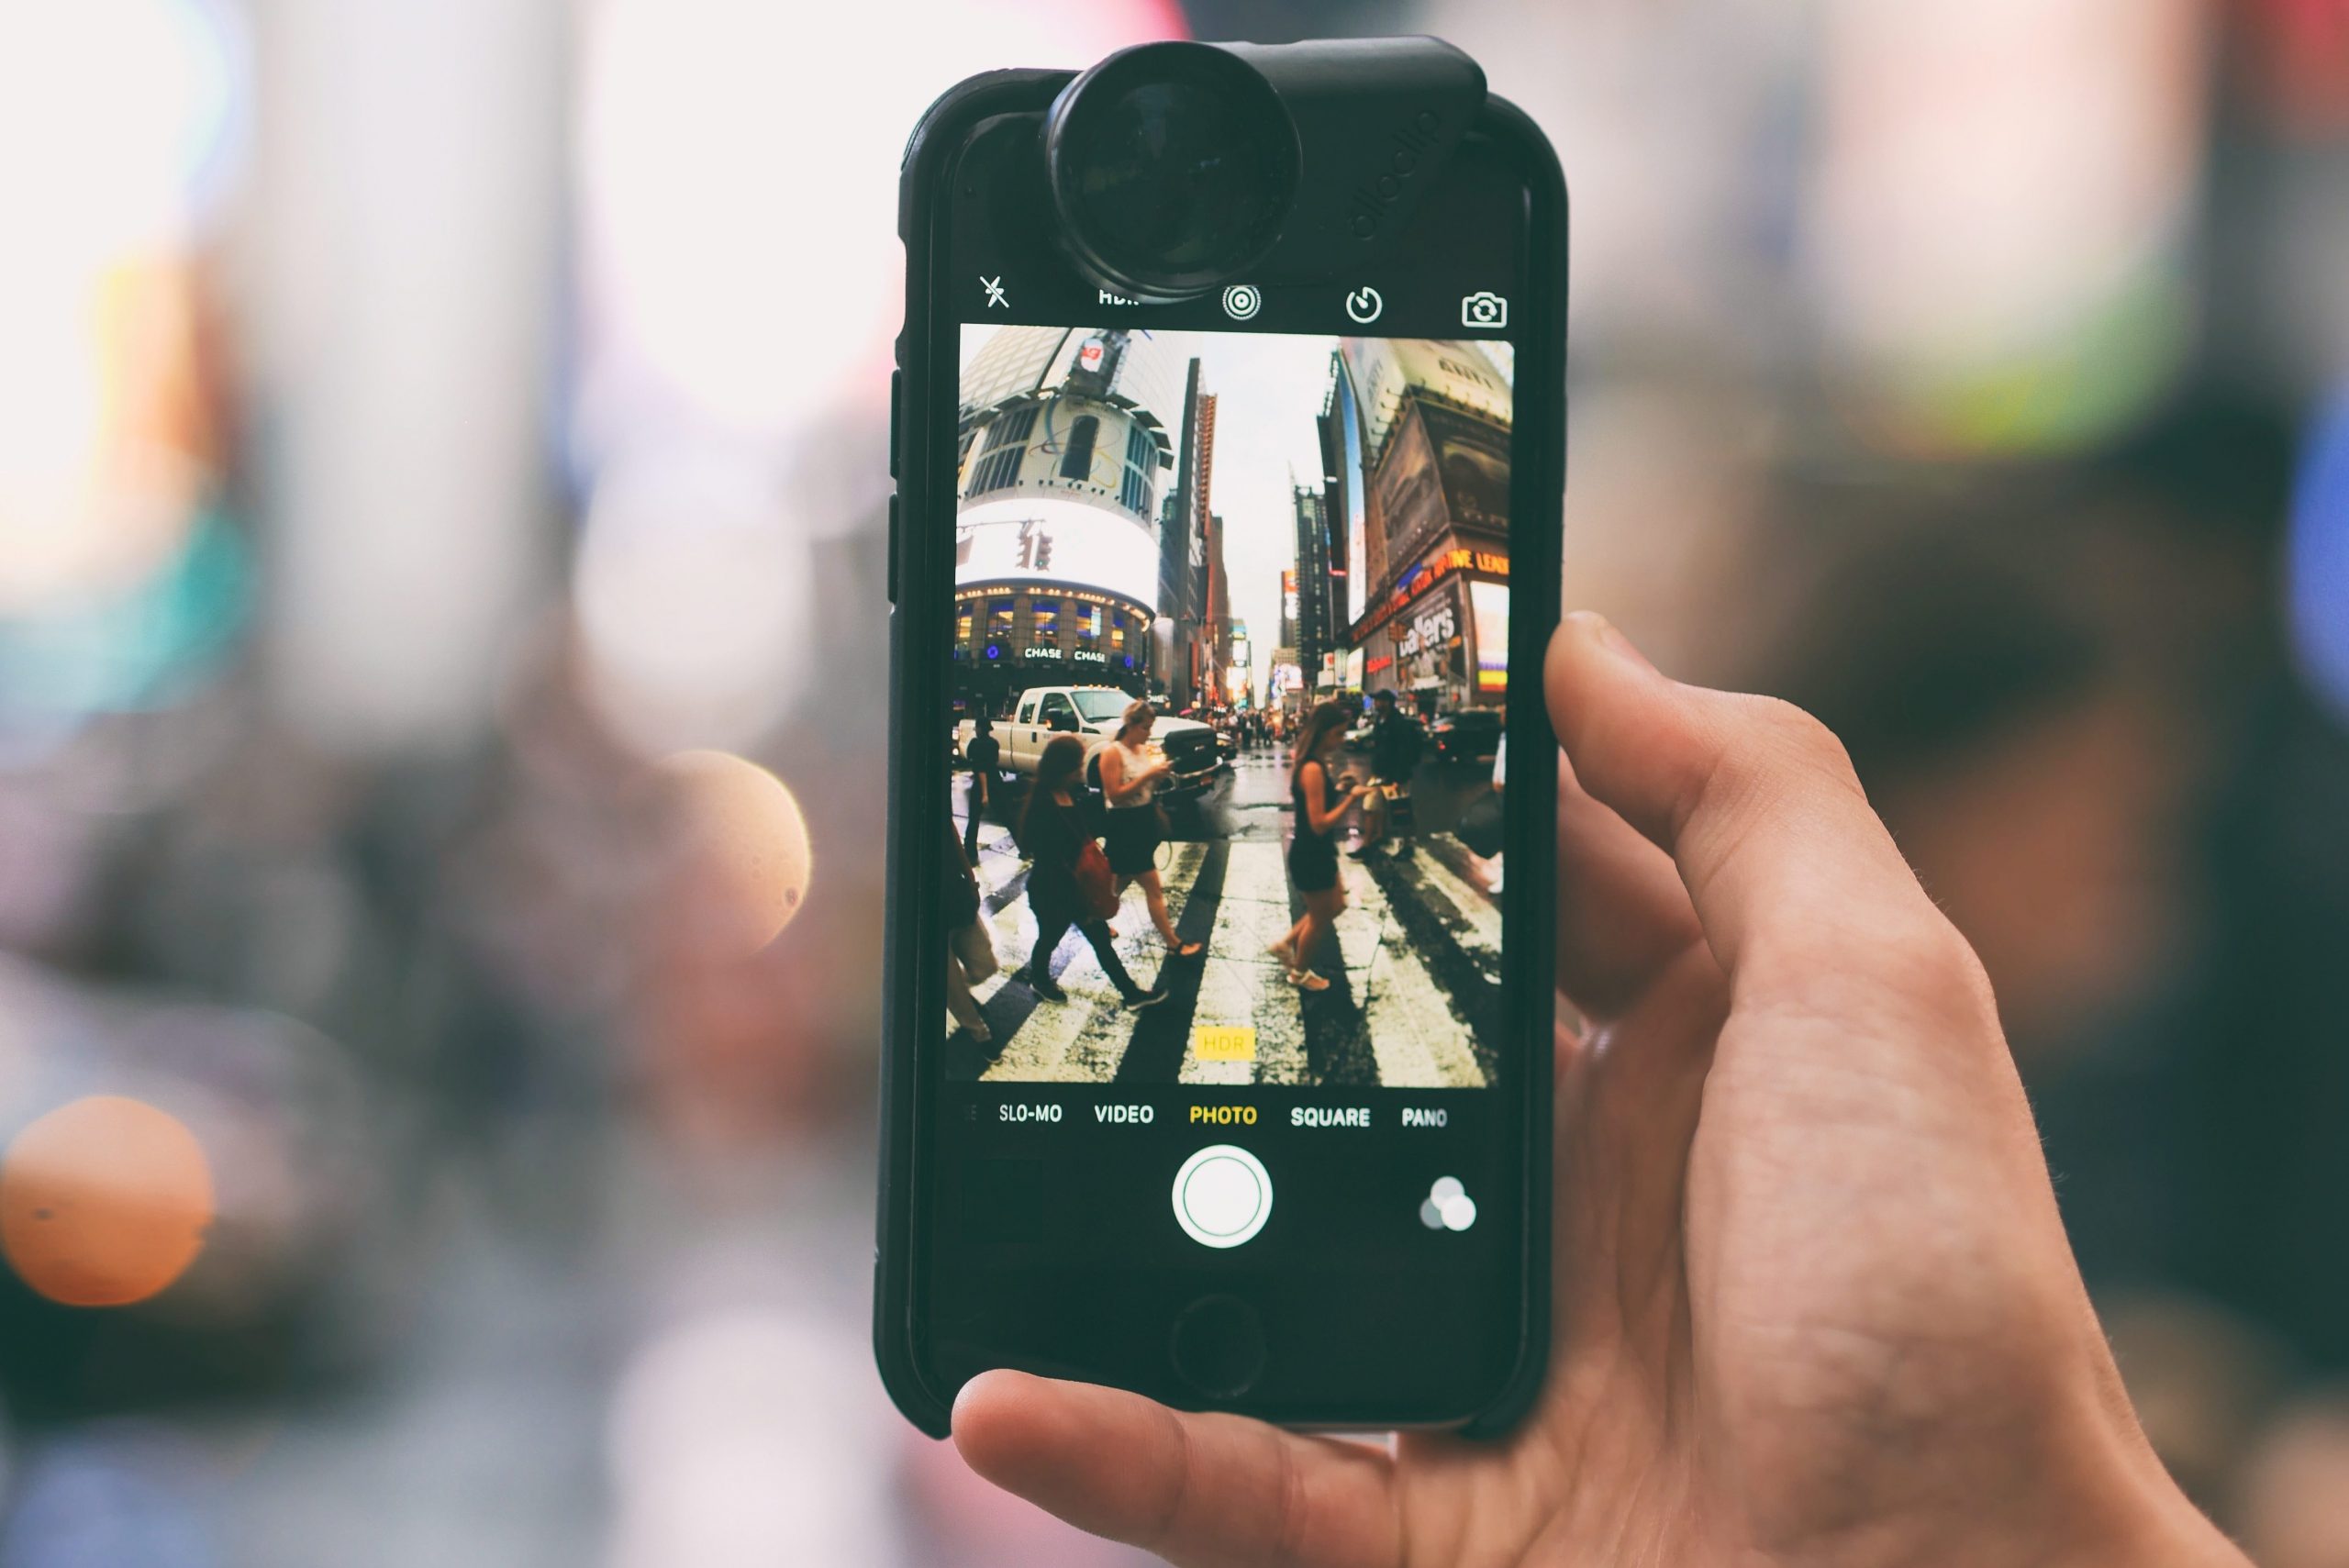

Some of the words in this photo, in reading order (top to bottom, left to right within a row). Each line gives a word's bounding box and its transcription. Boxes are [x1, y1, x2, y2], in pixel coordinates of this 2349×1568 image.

[1024, 648, 1063, 660] CHASE
[1203, 1035, 1245, 1052] HDR
[999, 1104, 1063, 1123] SLO-MO
[1094, 1105, 1154, 1124] VIDEO
[1189, 1106, 1258, 1126] PHOTO
[1290, 1106, 1371, 1128] SQUARE
[1401, 1107, 1448, 1128] PANO
